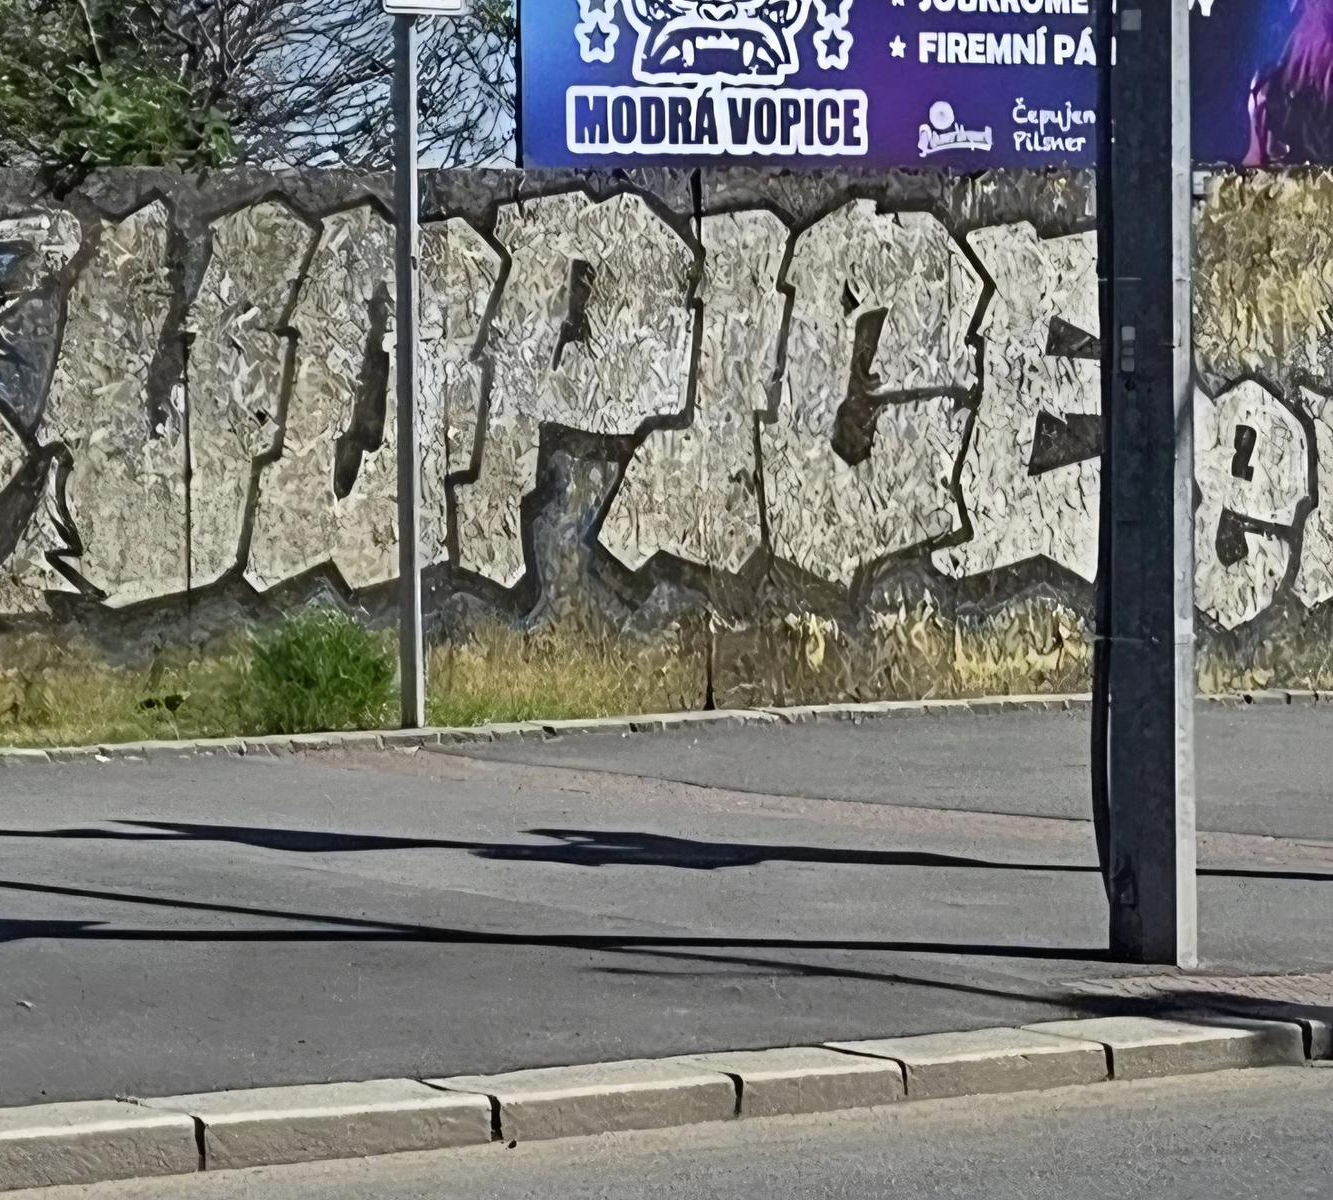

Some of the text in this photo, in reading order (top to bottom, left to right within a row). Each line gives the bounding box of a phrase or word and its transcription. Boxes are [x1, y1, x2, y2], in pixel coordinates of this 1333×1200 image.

[919, 26, 1047, 64] FIREMNÍ
[575, 87, 719, 145] MODRÁ
[727, 97, 862, 147] VOPICE
[1014, 131, 1086, 151] Pilsner
